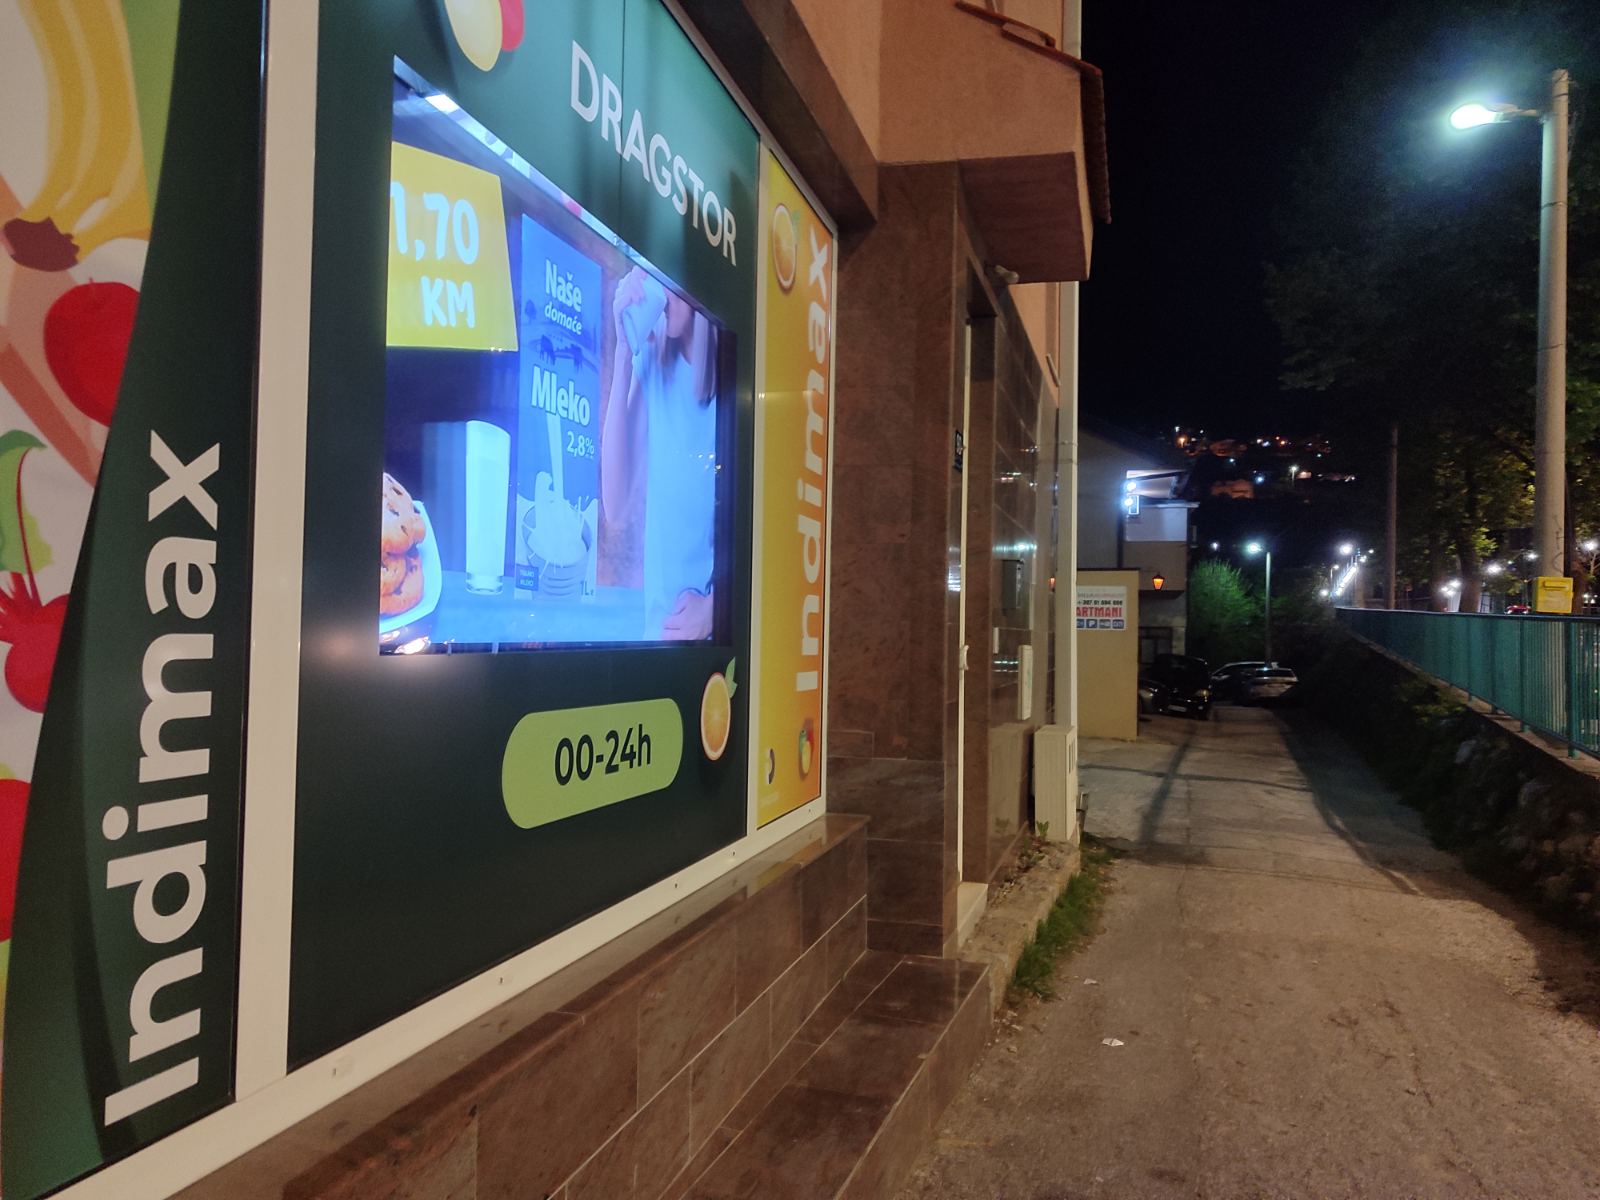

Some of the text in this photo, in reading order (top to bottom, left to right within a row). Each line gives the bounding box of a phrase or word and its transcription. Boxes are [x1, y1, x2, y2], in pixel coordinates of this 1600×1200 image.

[570, 40, 737, 266] DRAGSTOR
[390, 181, 480, 265] 1,70
[420, 275, 476, 329] KM
[545, 259, 582, 313] Naše
[545, 302, 582, 336] domaće
[531, 365, 591, 427] Mleko
[567, 431, 595, 459] 2,8%
[796, 224, 827, 692] Indimax
[102, 429, 220, 1127] Indimax
[554, 724, 652, 786] 00-24h
